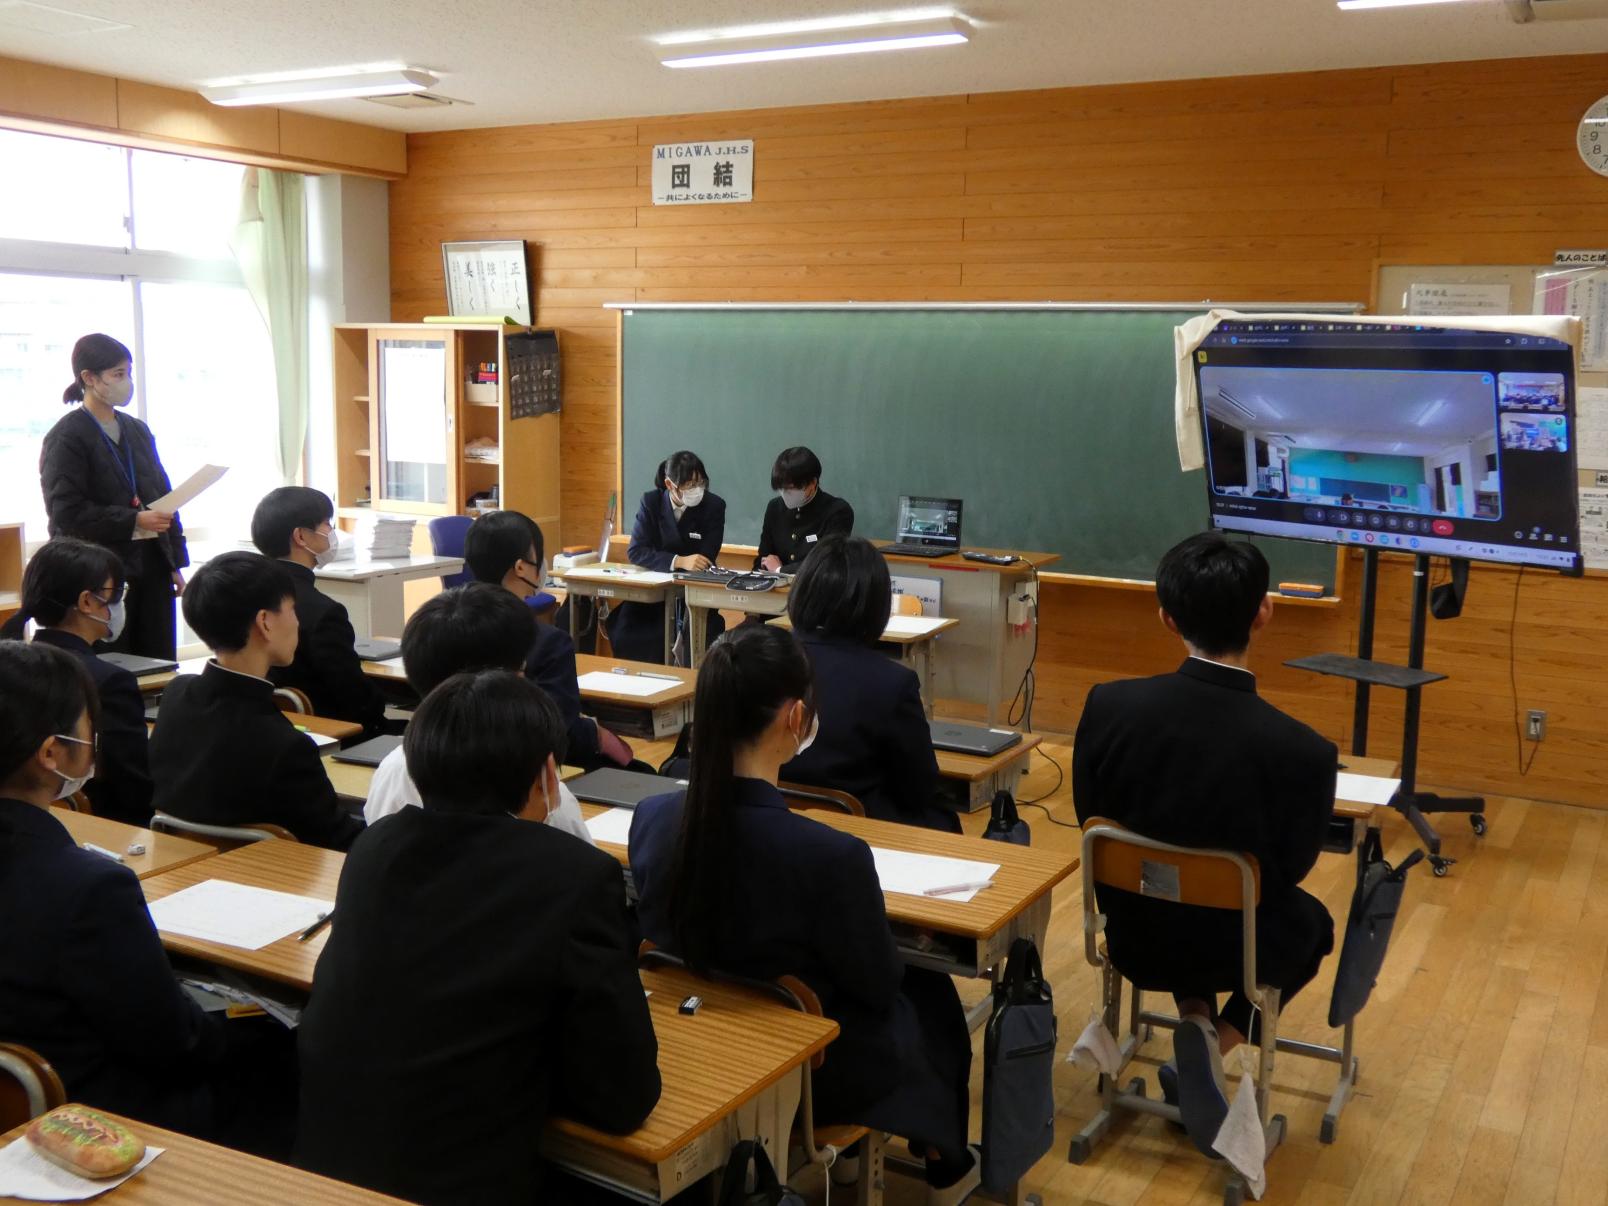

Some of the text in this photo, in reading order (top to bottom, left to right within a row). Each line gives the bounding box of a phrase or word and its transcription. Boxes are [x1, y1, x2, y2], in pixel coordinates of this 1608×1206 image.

[1590, 131, 1599, 141] 9
[657, 144, 712, 159] MIGAWA
[1592, 144, 1602, 155] 8
[464, 261, 475, 311] 美しく
[510, 261, 521, 310] 正しく
